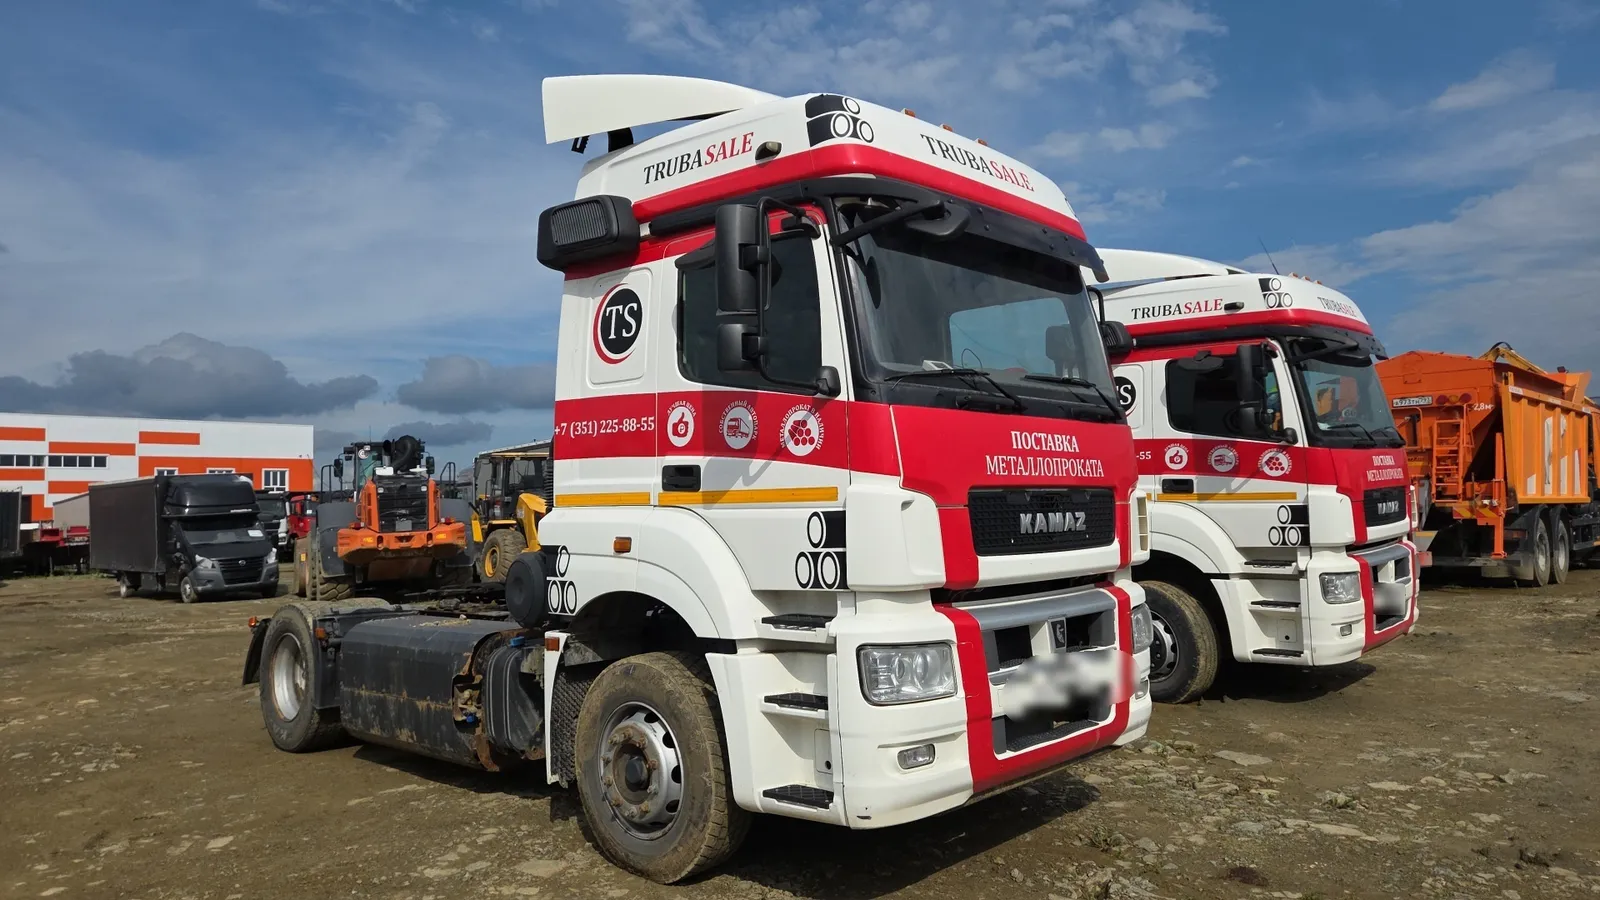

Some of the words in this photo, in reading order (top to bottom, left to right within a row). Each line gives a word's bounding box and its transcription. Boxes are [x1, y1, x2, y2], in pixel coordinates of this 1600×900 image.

[643, 132, 754, 185] TRUBASALE
[920, 133, 1034, 192] TRUBASALE
[605, 302, 638, 339] TS
[1131, 298, 1223, 320] TRUBASALE
[1116, 384, 1132, 405] S
[554, 422, 567, 435] +7
[570, 420, 598, 439] (351)
[600, 416, 655, 433] 225-88-55
[1010, 430, 1080, 452] ПОСТАВКА
[985, 455, 1104, 477] МЕТАЛЛОПРОКАТА
[1019, 511, 1086, 534] KAMAZ
